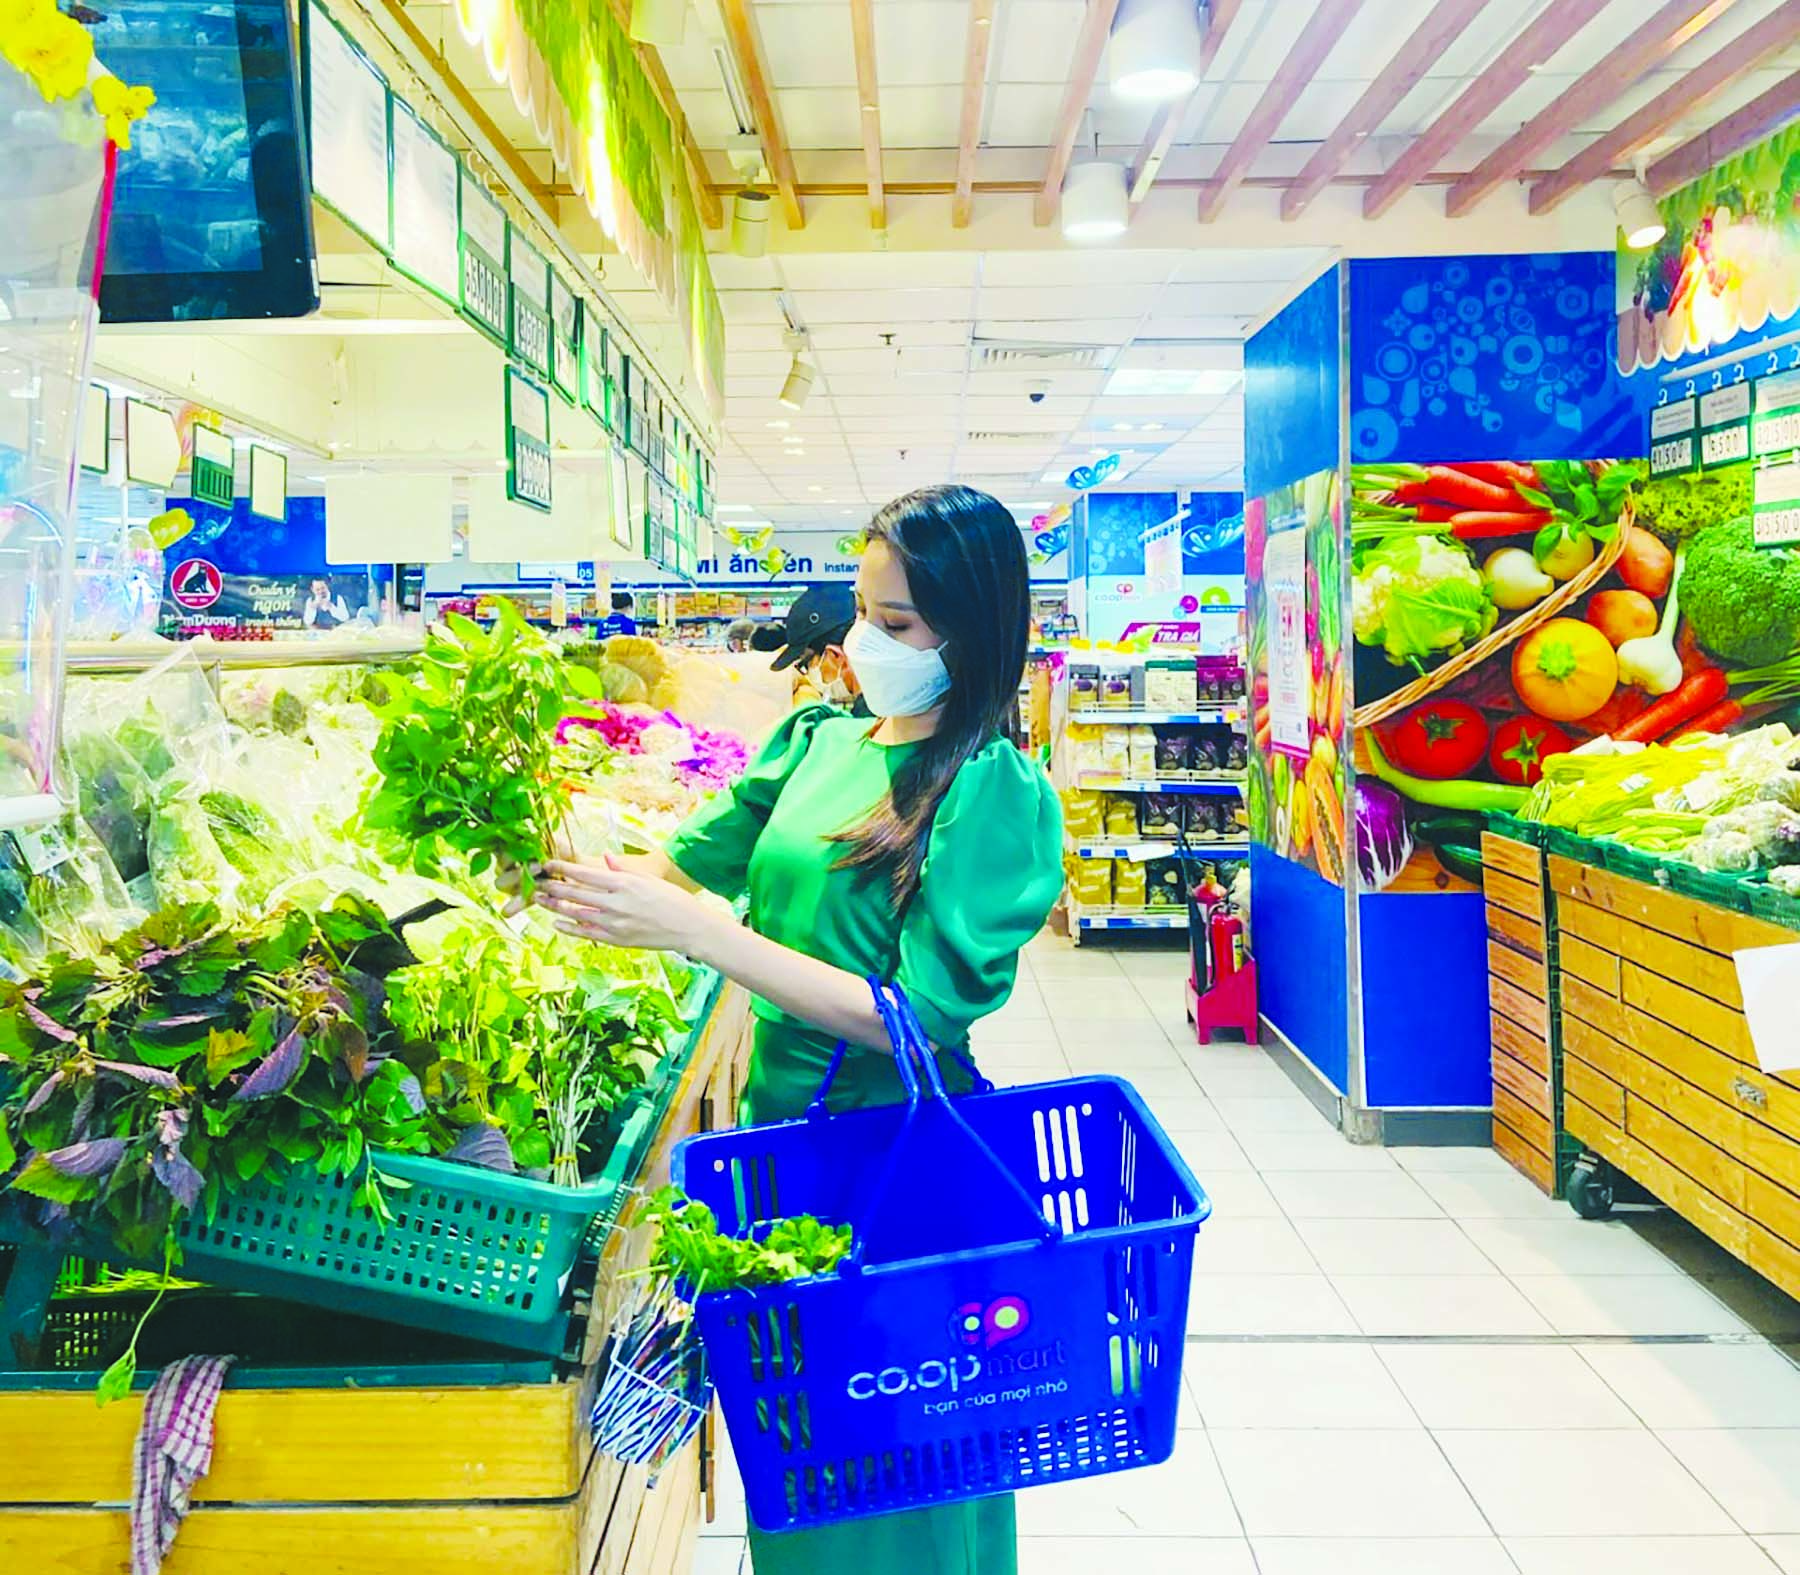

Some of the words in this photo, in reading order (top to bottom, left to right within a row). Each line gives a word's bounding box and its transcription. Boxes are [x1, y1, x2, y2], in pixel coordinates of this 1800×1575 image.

[729, 553, 759, 573] ăn
[824, 562, 860, 573] Instan
[579, 568, 593, 578] 05
[253, 600, 291, 616] ngon
[1001, 1384, 1031, 1402] mọi
